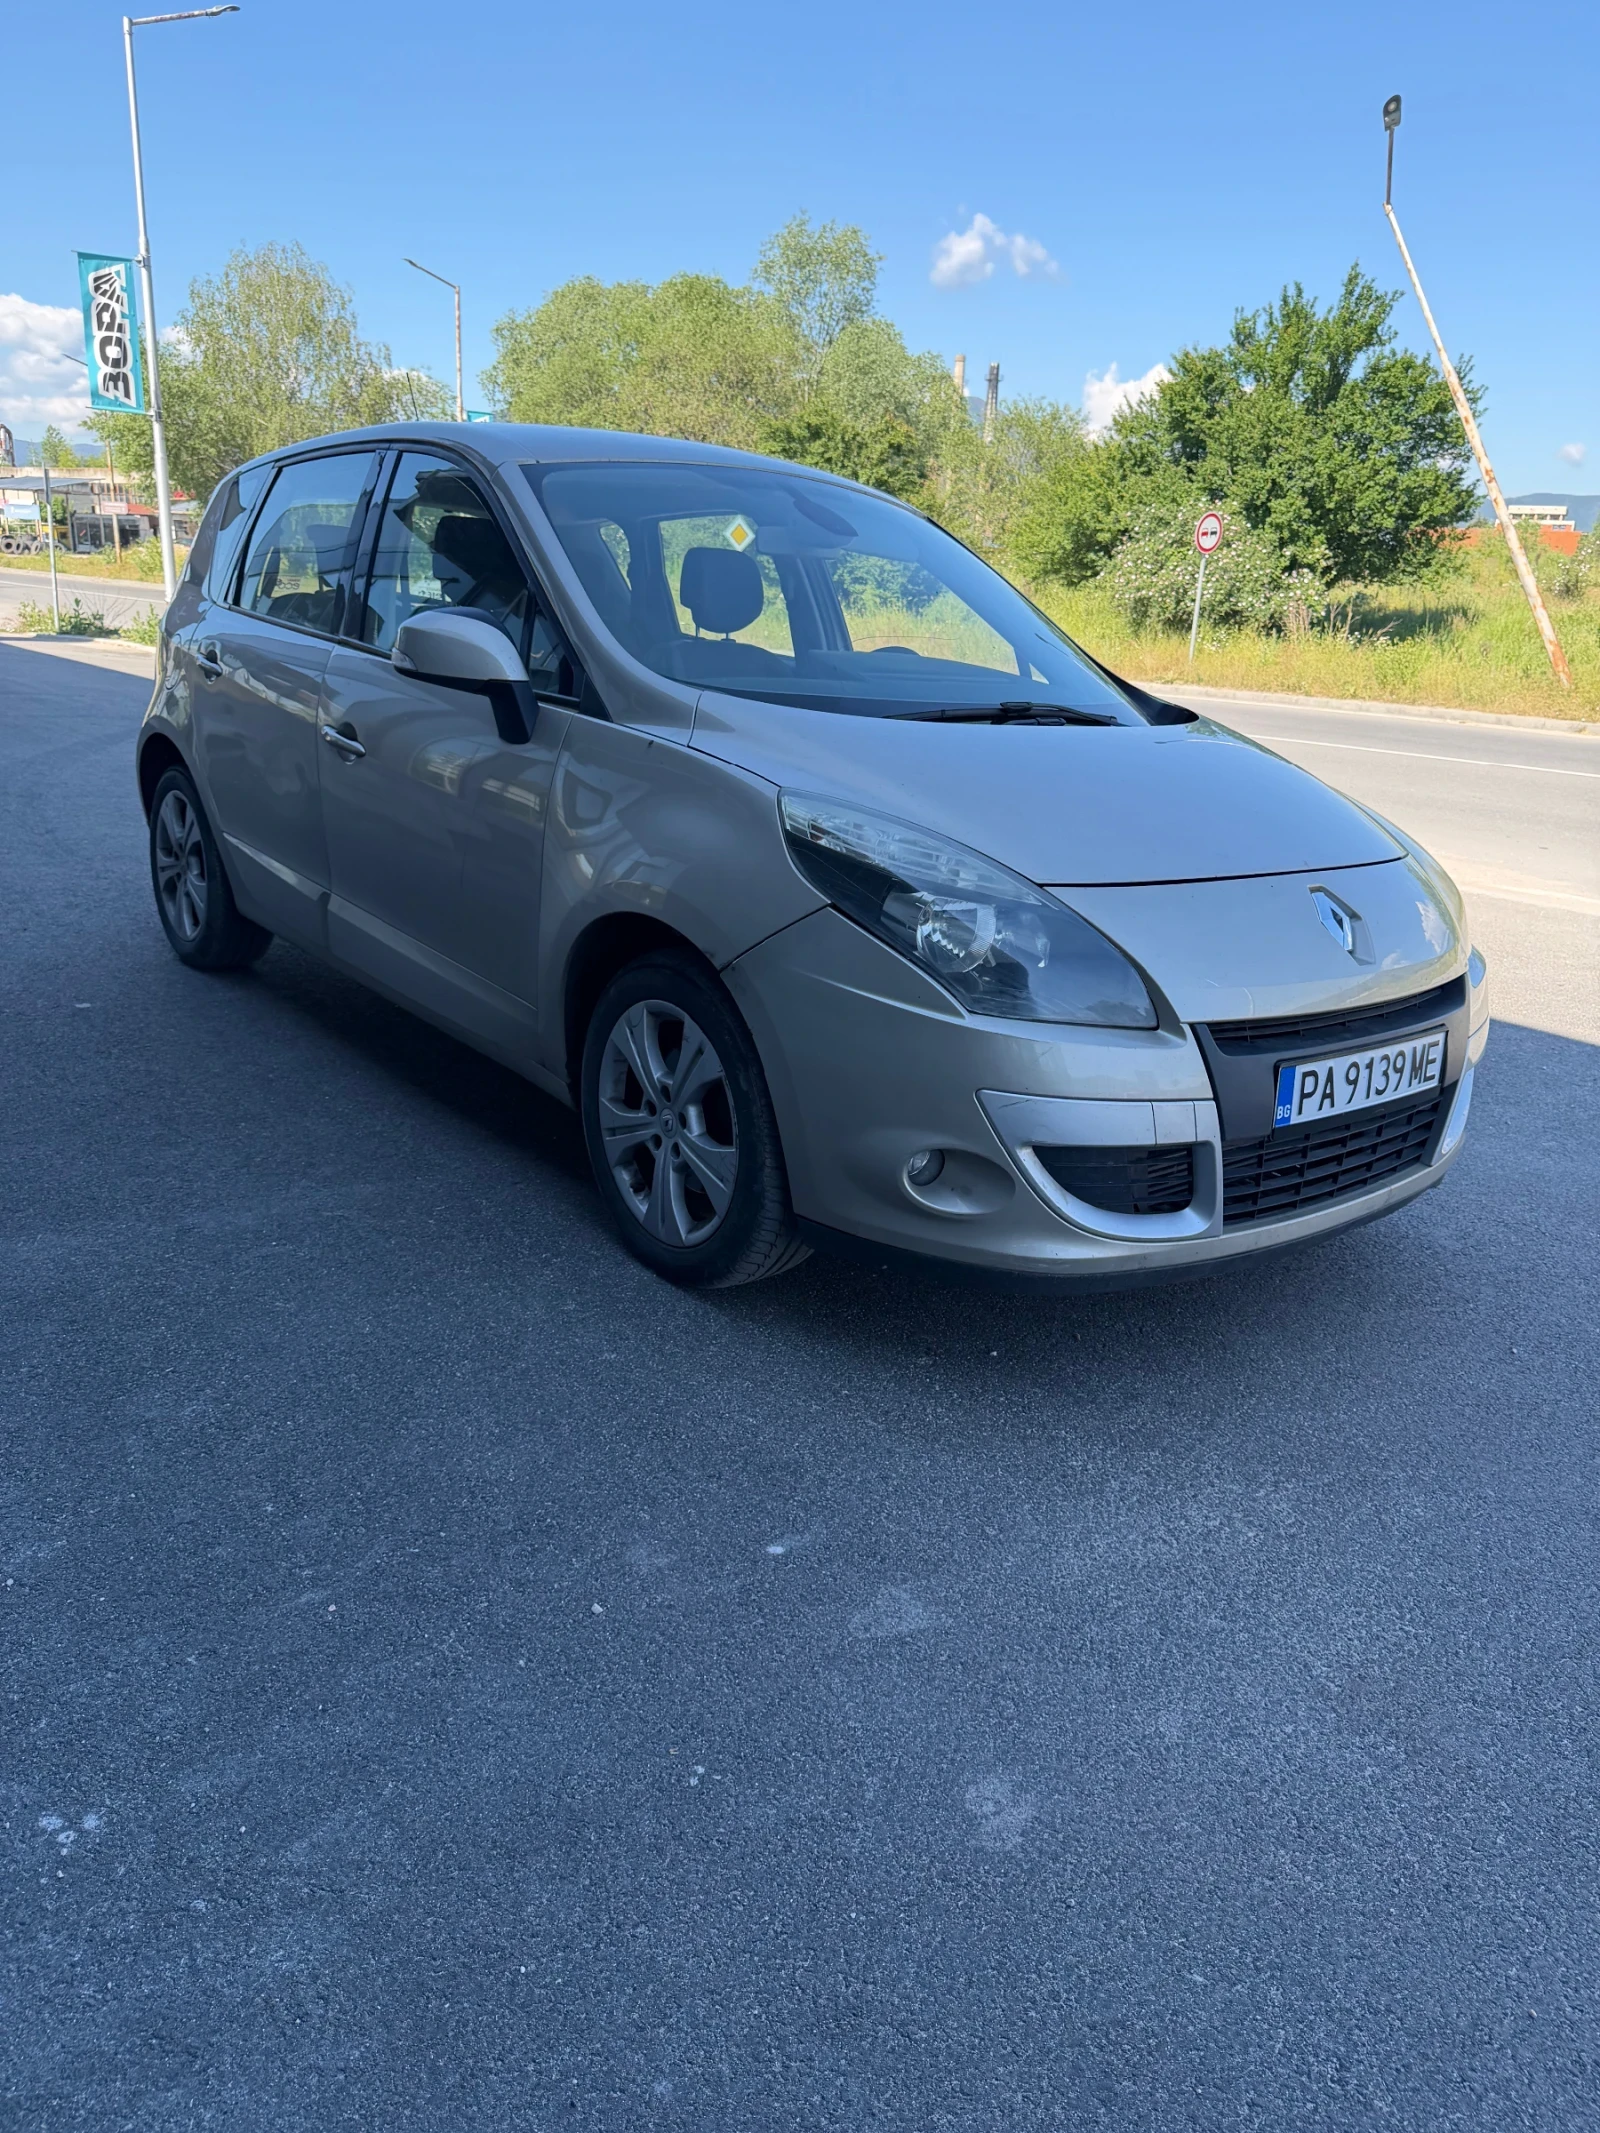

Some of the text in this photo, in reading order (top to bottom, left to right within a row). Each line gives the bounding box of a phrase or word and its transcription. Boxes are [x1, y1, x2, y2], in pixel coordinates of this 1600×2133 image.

[1297, 1040, 1440, 1116] PA 9139 ME
[1276, 1104, 1291, 1120] BG
